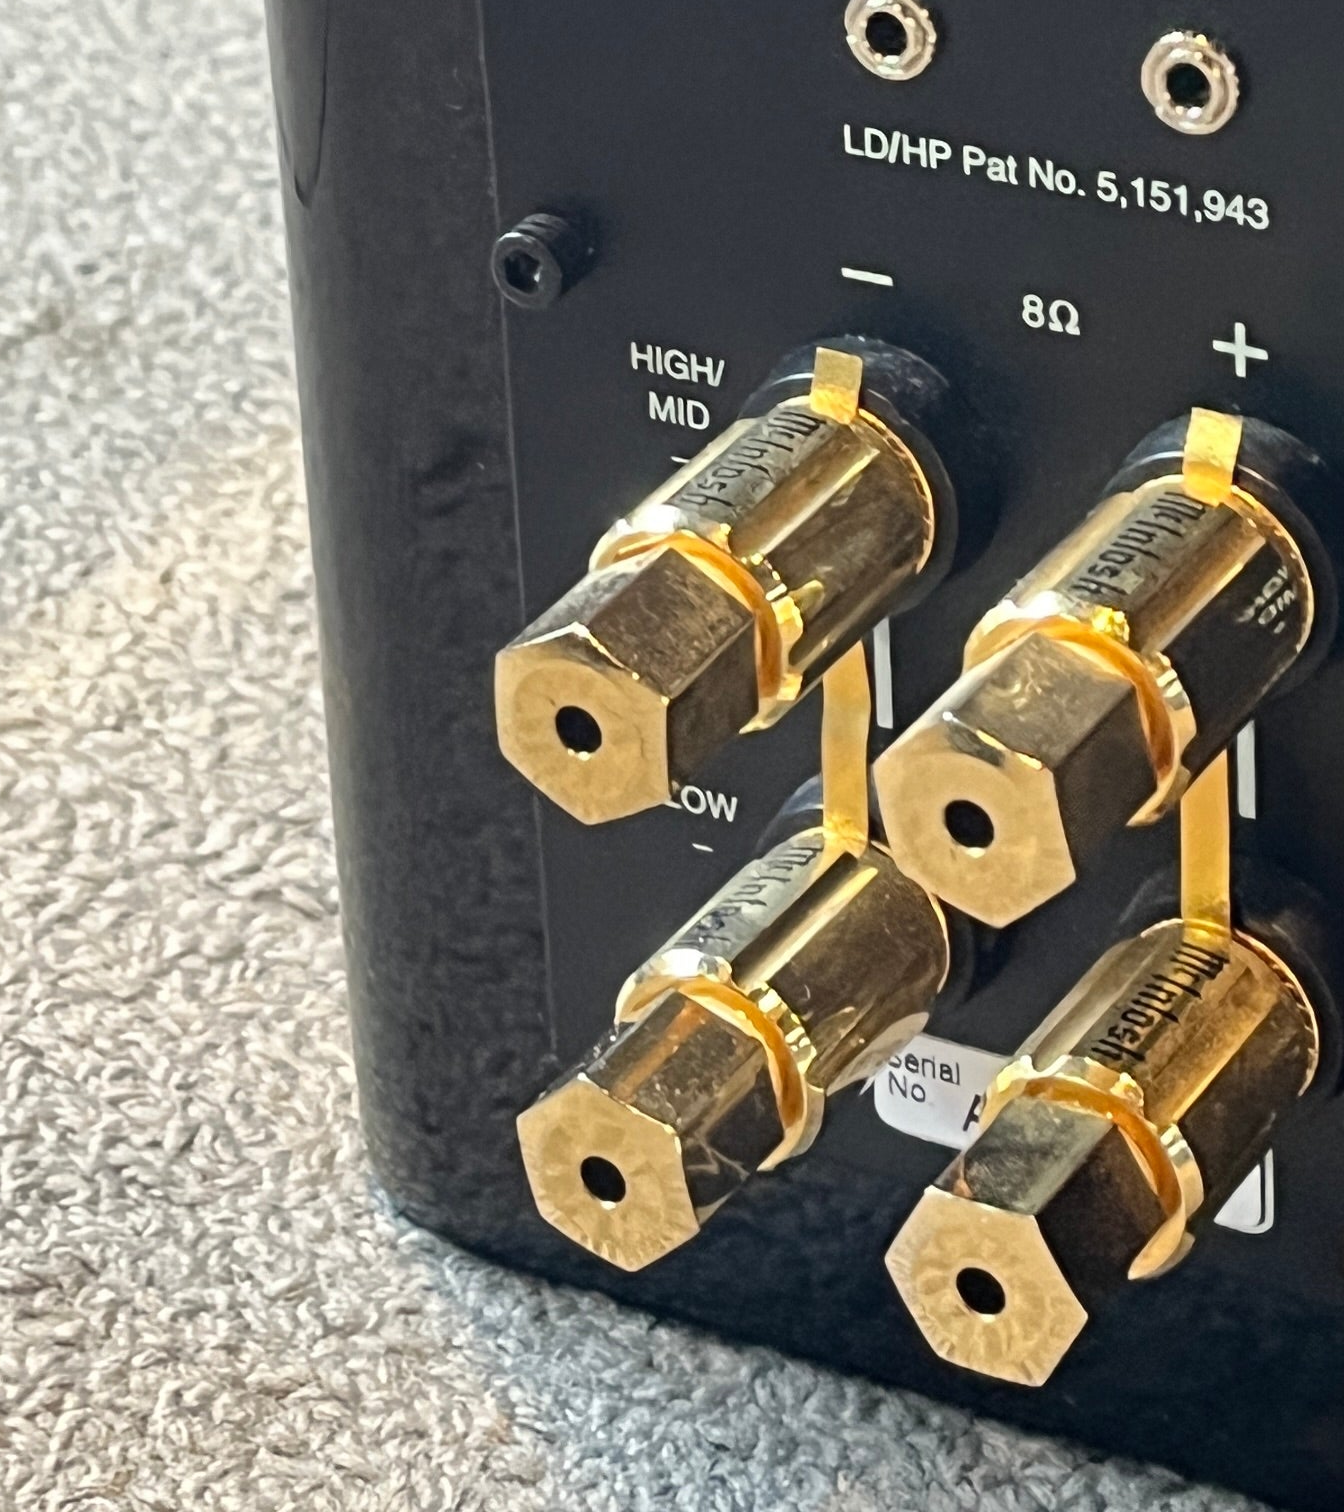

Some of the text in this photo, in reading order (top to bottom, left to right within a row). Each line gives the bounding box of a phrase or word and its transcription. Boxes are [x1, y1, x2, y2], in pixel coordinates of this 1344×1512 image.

[843, 123, 1270, 230] LD/HP Pat No. 5,151,943
[630, 341, 725, 387] HIGH/
[648, 390, 710, 430] MID
[888, 1070, 926, 1103] No
